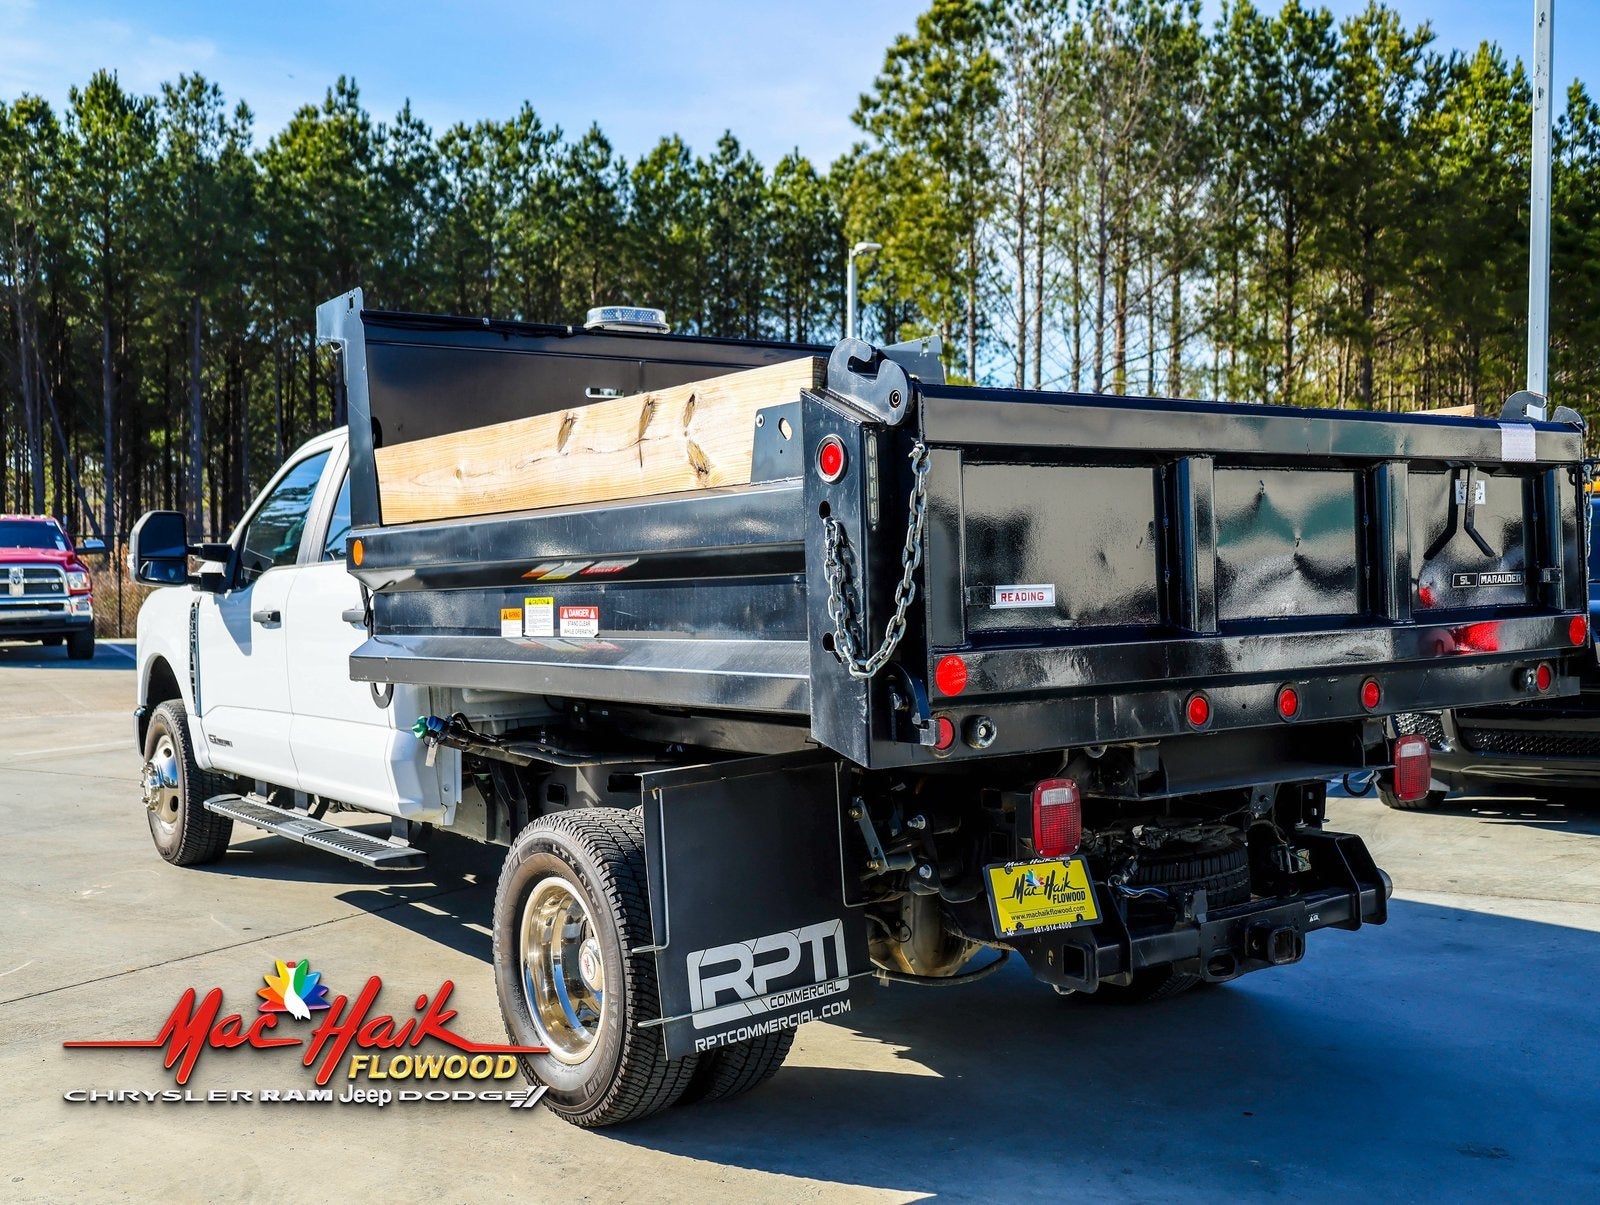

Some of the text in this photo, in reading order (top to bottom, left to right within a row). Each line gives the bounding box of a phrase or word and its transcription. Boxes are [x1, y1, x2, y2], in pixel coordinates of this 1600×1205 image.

[1460, 574, 1522, 585] SL MARAUDER
[1000, 592, 1045, 602] READING
[568, 608, 590, 618] DANGER
[1001, 870, 1085, 905] Mac Haik
[1052, 891, 1085, 904] FLOWOOD
[1011, 905, 1085, 920] www.machaikflowood.com
[692, 918, 849, 1014] RPT
[769, 981, 841, 1010] COMMERCIAL
[694, 999, 851, 1053] RPTCOMMERCIAL.COM
